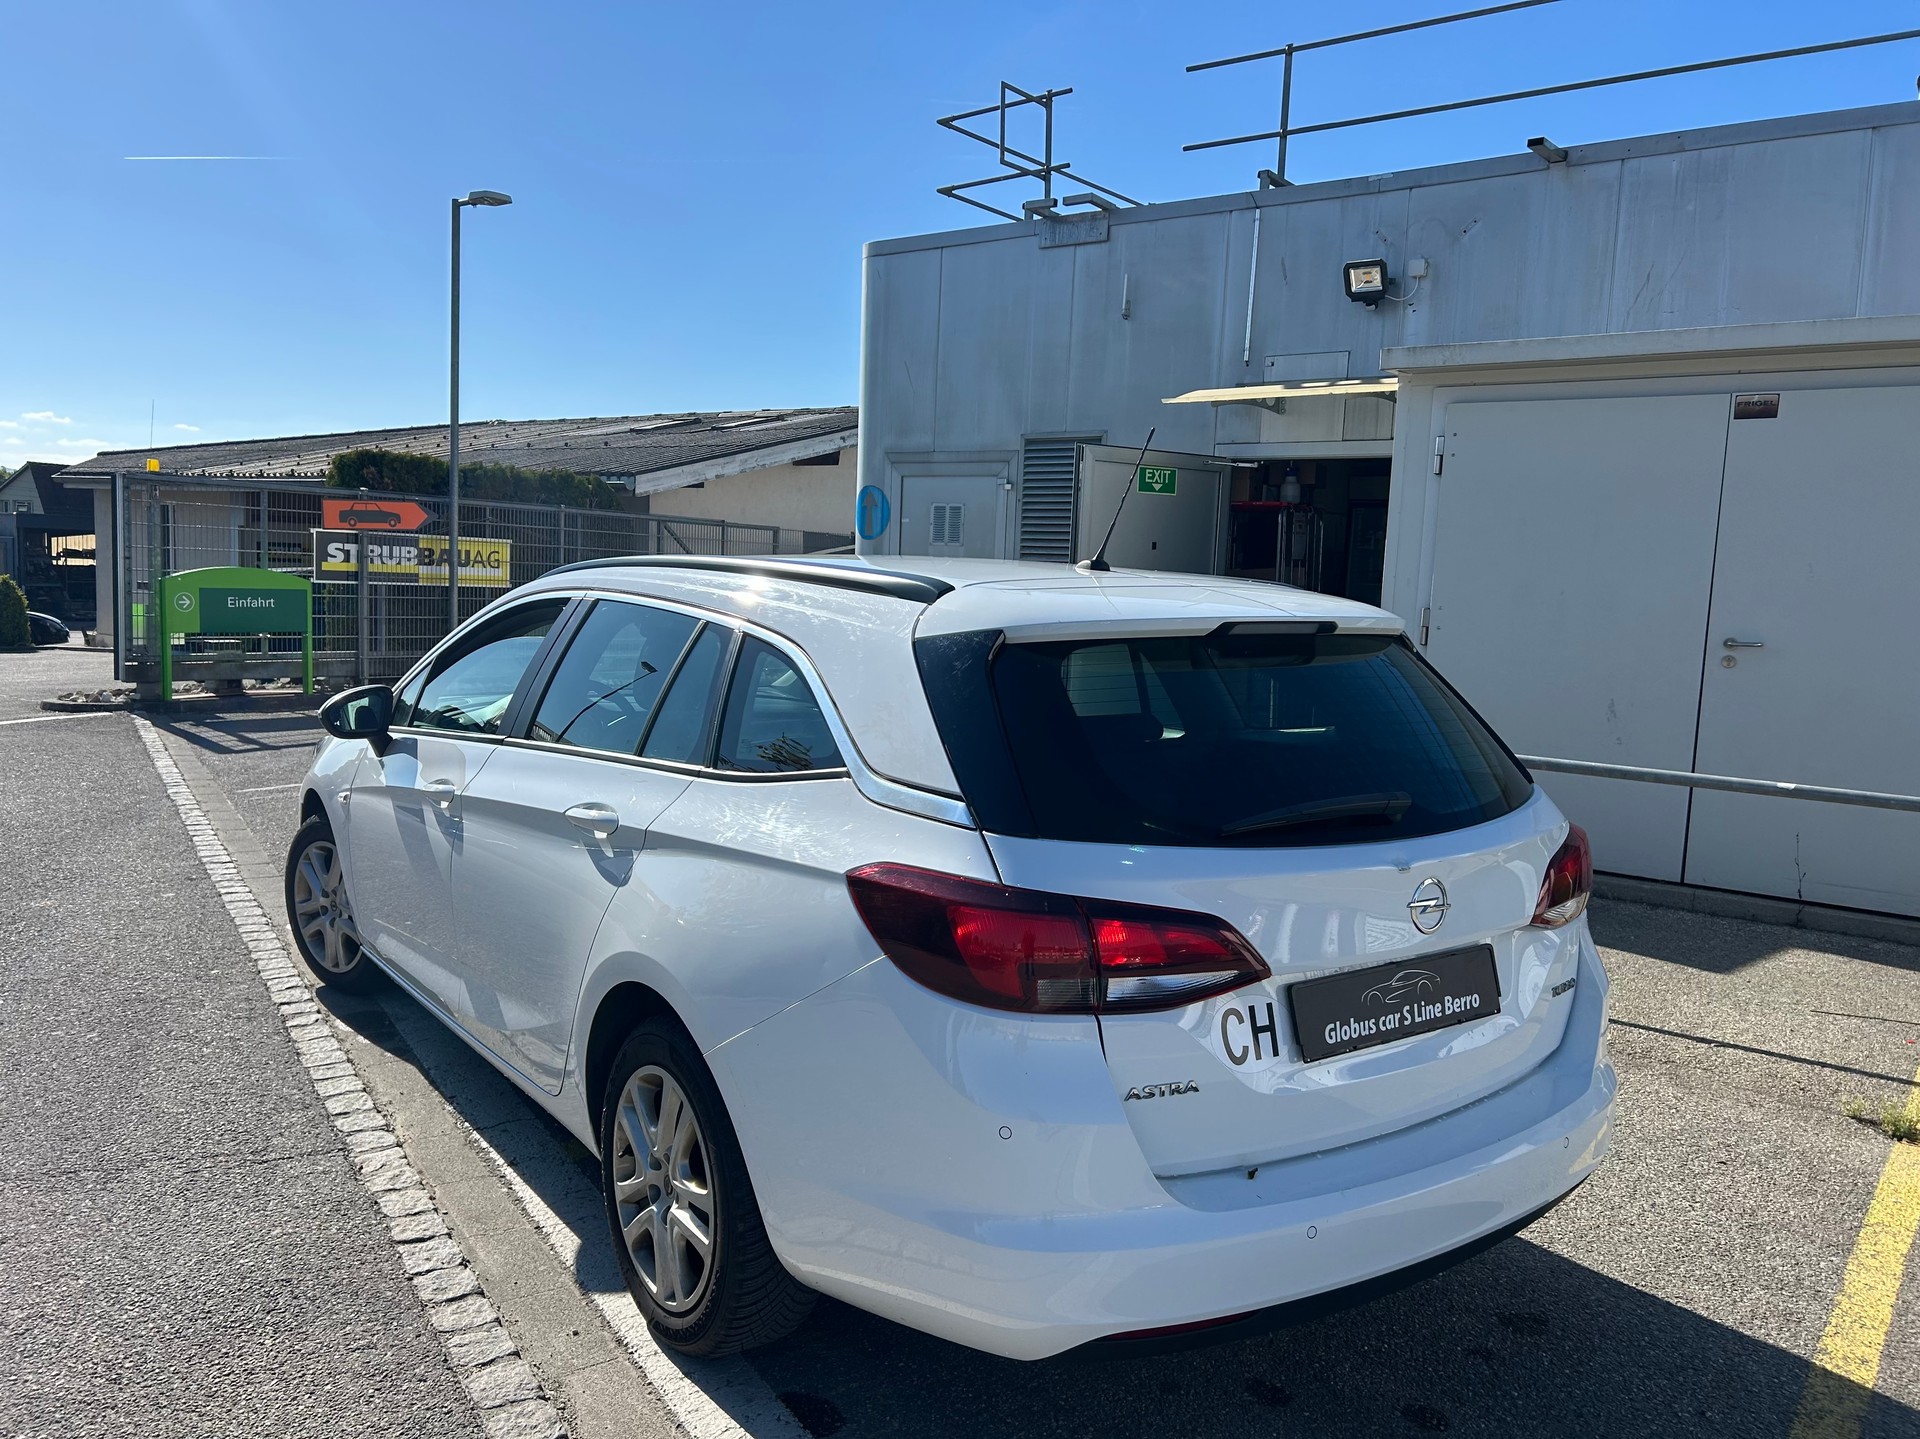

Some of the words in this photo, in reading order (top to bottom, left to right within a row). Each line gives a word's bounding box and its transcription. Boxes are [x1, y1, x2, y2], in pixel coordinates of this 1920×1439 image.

[1145, 469, 1171, 483] EXIT
[227, 596, 275, 608] Einfahrt
[1325, 1018, 1376, 1044] Globus
[1379, 1012, 1401, 1031] car
[1403, 1005, 1411, 1026] S
[1414, 1001, 1443, 1023] Line
[1444, 993, 1480, 1015] Berro
[1221, 1002, 1280, 1066] CH
[1124, 1080, 1200, 1101] ASTRA
